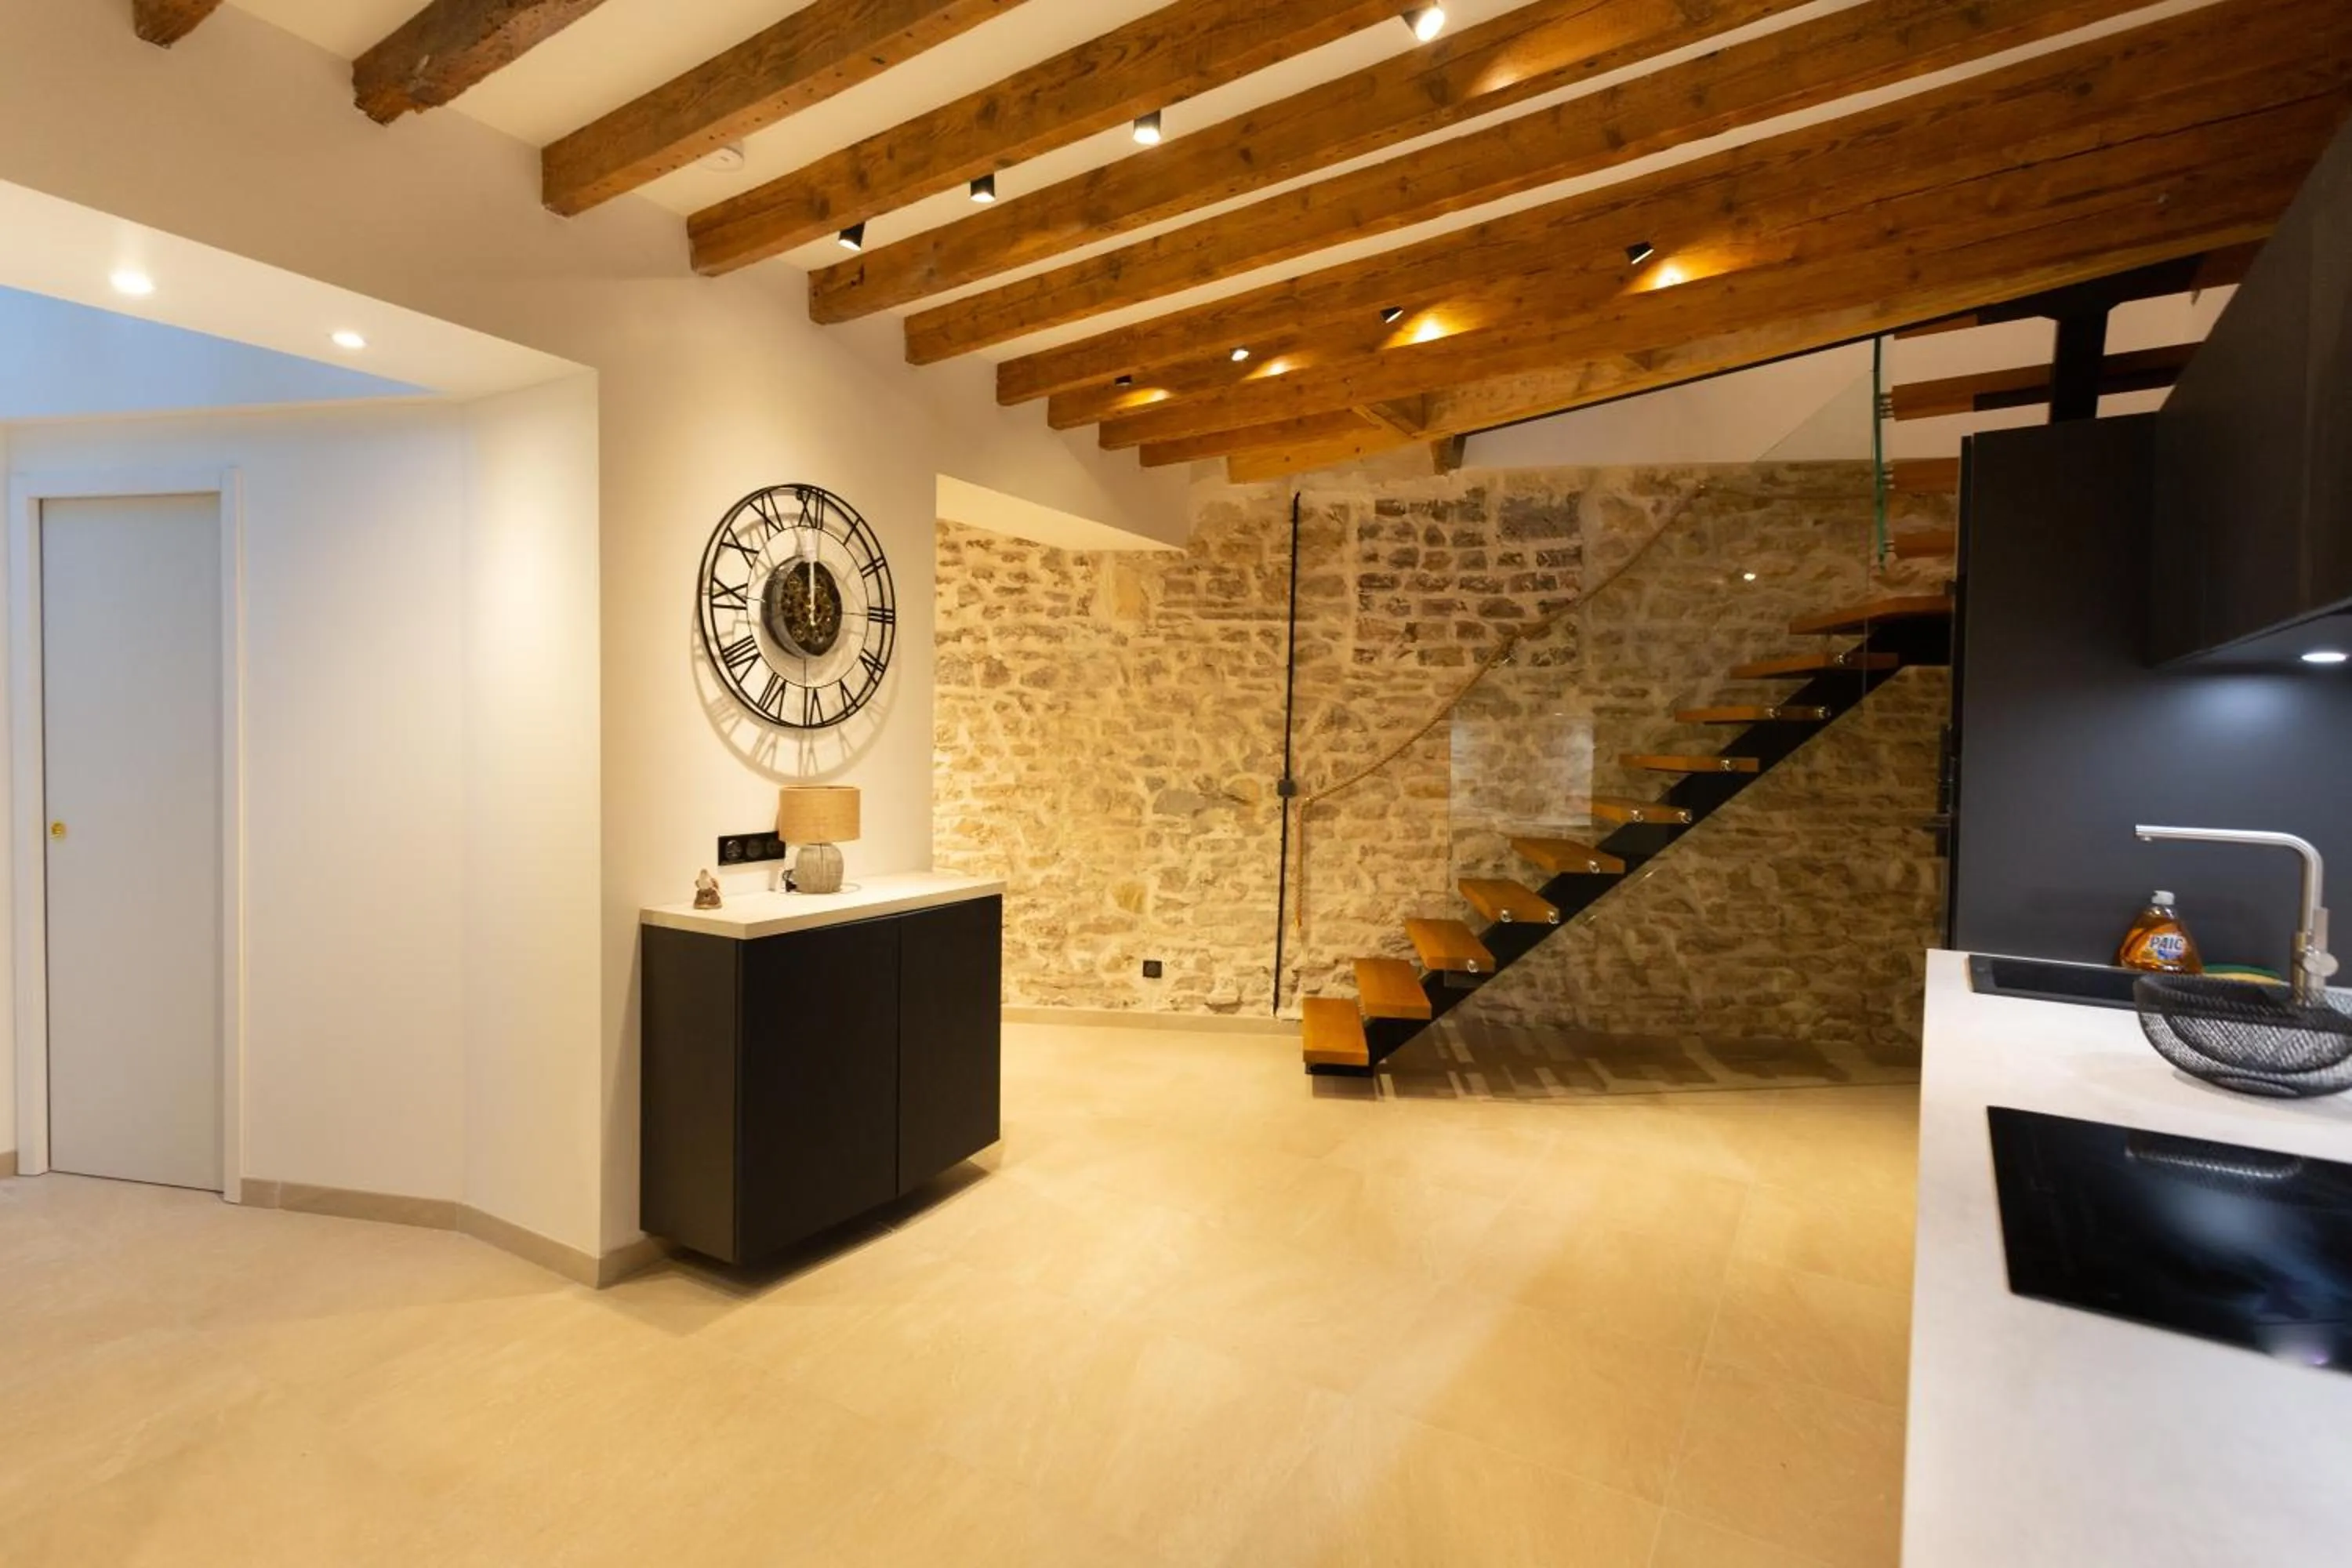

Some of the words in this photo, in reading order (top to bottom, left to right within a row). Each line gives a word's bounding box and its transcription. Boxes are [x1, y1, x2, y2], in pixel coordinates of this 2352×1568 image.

[749, 490, 785, 540] XI
[797, 489, 825, 530] XII
[720, 526, 759, 568] X
[860, 556, 887, 578] II
[711, 577, 748, 610] IX
[867, 606, 895, 624] III
[722, 634, 760, 684] VIII
[859, 648, 886, 686] IV
[757, 672, 787, 720] VII
[803, 687, 825, 727] VI
[838, 679, 859, 717] V
[2151, 937, 2183, 950] PAIC
